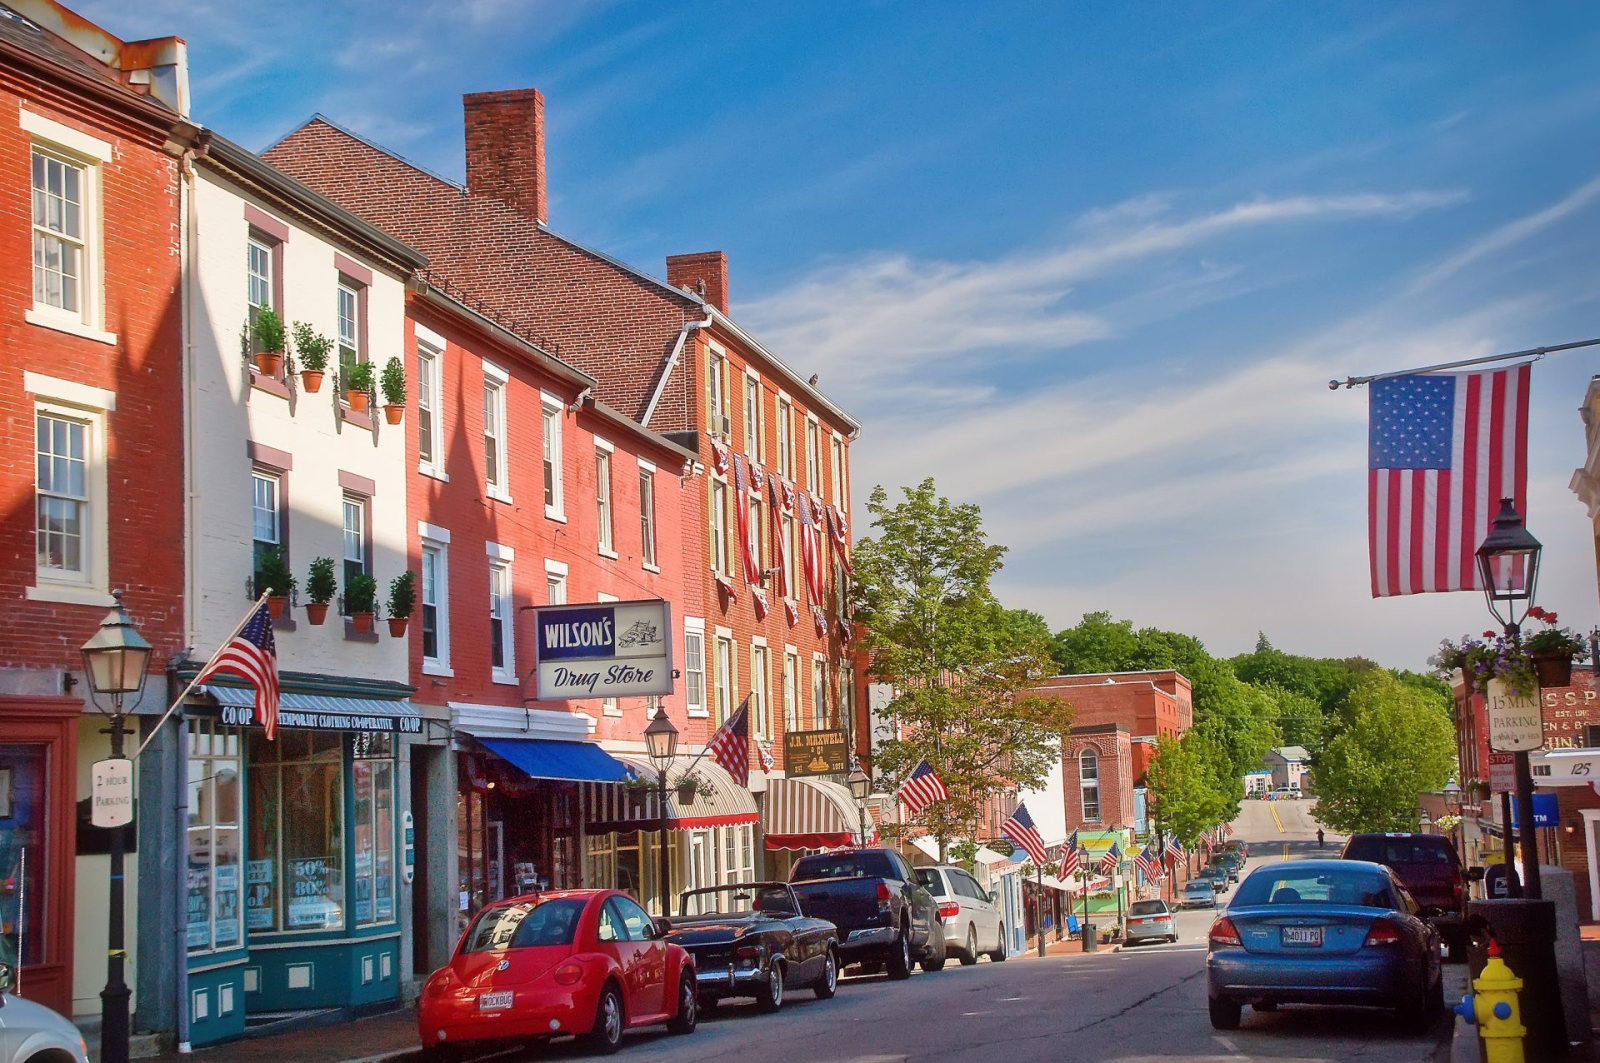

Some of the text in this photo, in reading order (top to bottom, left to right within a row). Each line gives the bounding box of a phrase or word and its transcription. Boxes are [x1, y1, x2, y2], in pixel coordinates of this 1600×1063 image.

[545, 616, 612, 648] WILSON'S
[554, 665, 653, 693] Drug Store
[1493, 696, 1505, 709] 15
[320, 716, 350, 728] CLOTHING
[1494, 716, 1537, 728] PARKING
[806, 733, 844, 746] MAXWELL
[1490, 755, 1513, 763] STOP
[1571, 763, 1591, 775] 125
[97, 776, 128, 786] 2 HOUR
[96, 797, 130, 806] PARKING
